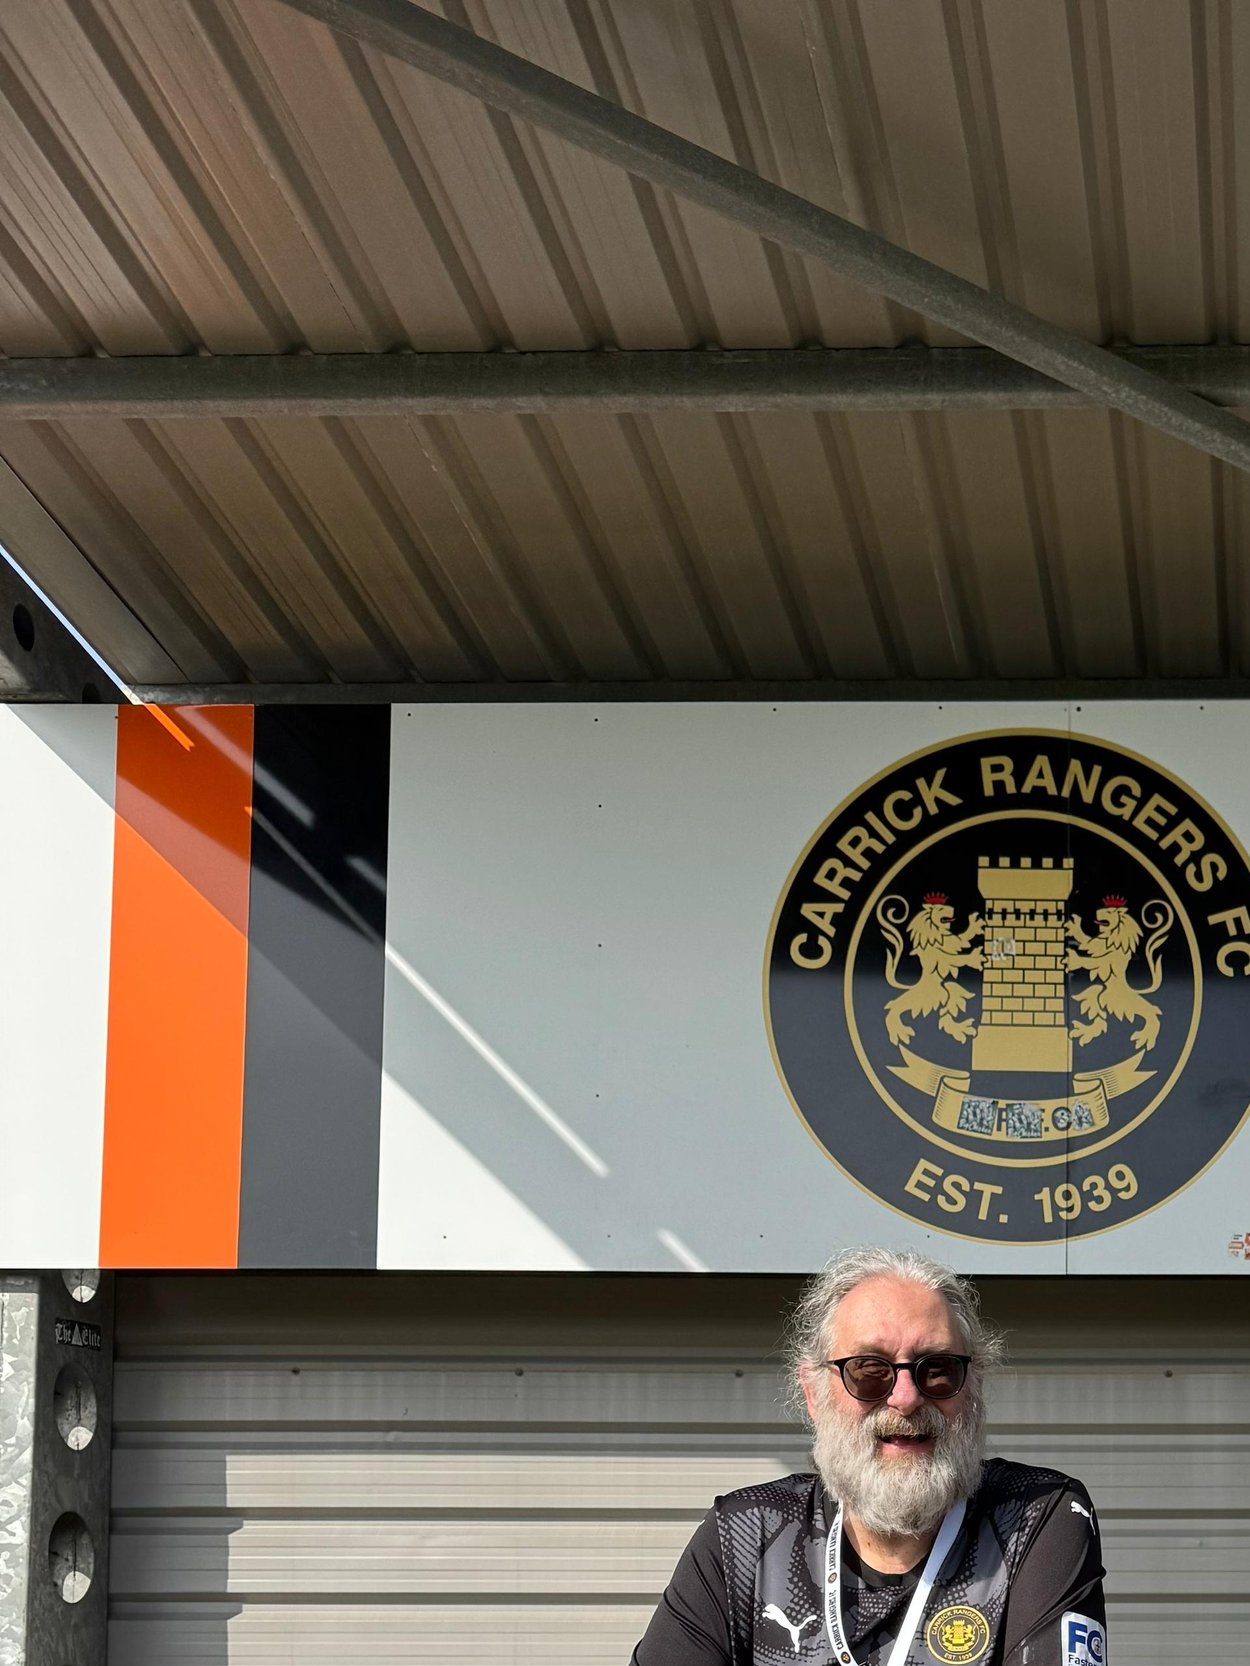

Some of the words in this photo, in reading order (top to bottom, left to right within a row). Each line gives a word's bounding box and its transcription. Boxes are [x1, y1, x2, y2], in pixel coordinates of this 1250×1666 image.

[790, 767, 963, 970] CARRICK
[980, 755, 1228, 892] RANGERS
[904, 1158, 1009, 1223] EST.
[1034, 1163, 1138, 1223] 1939
